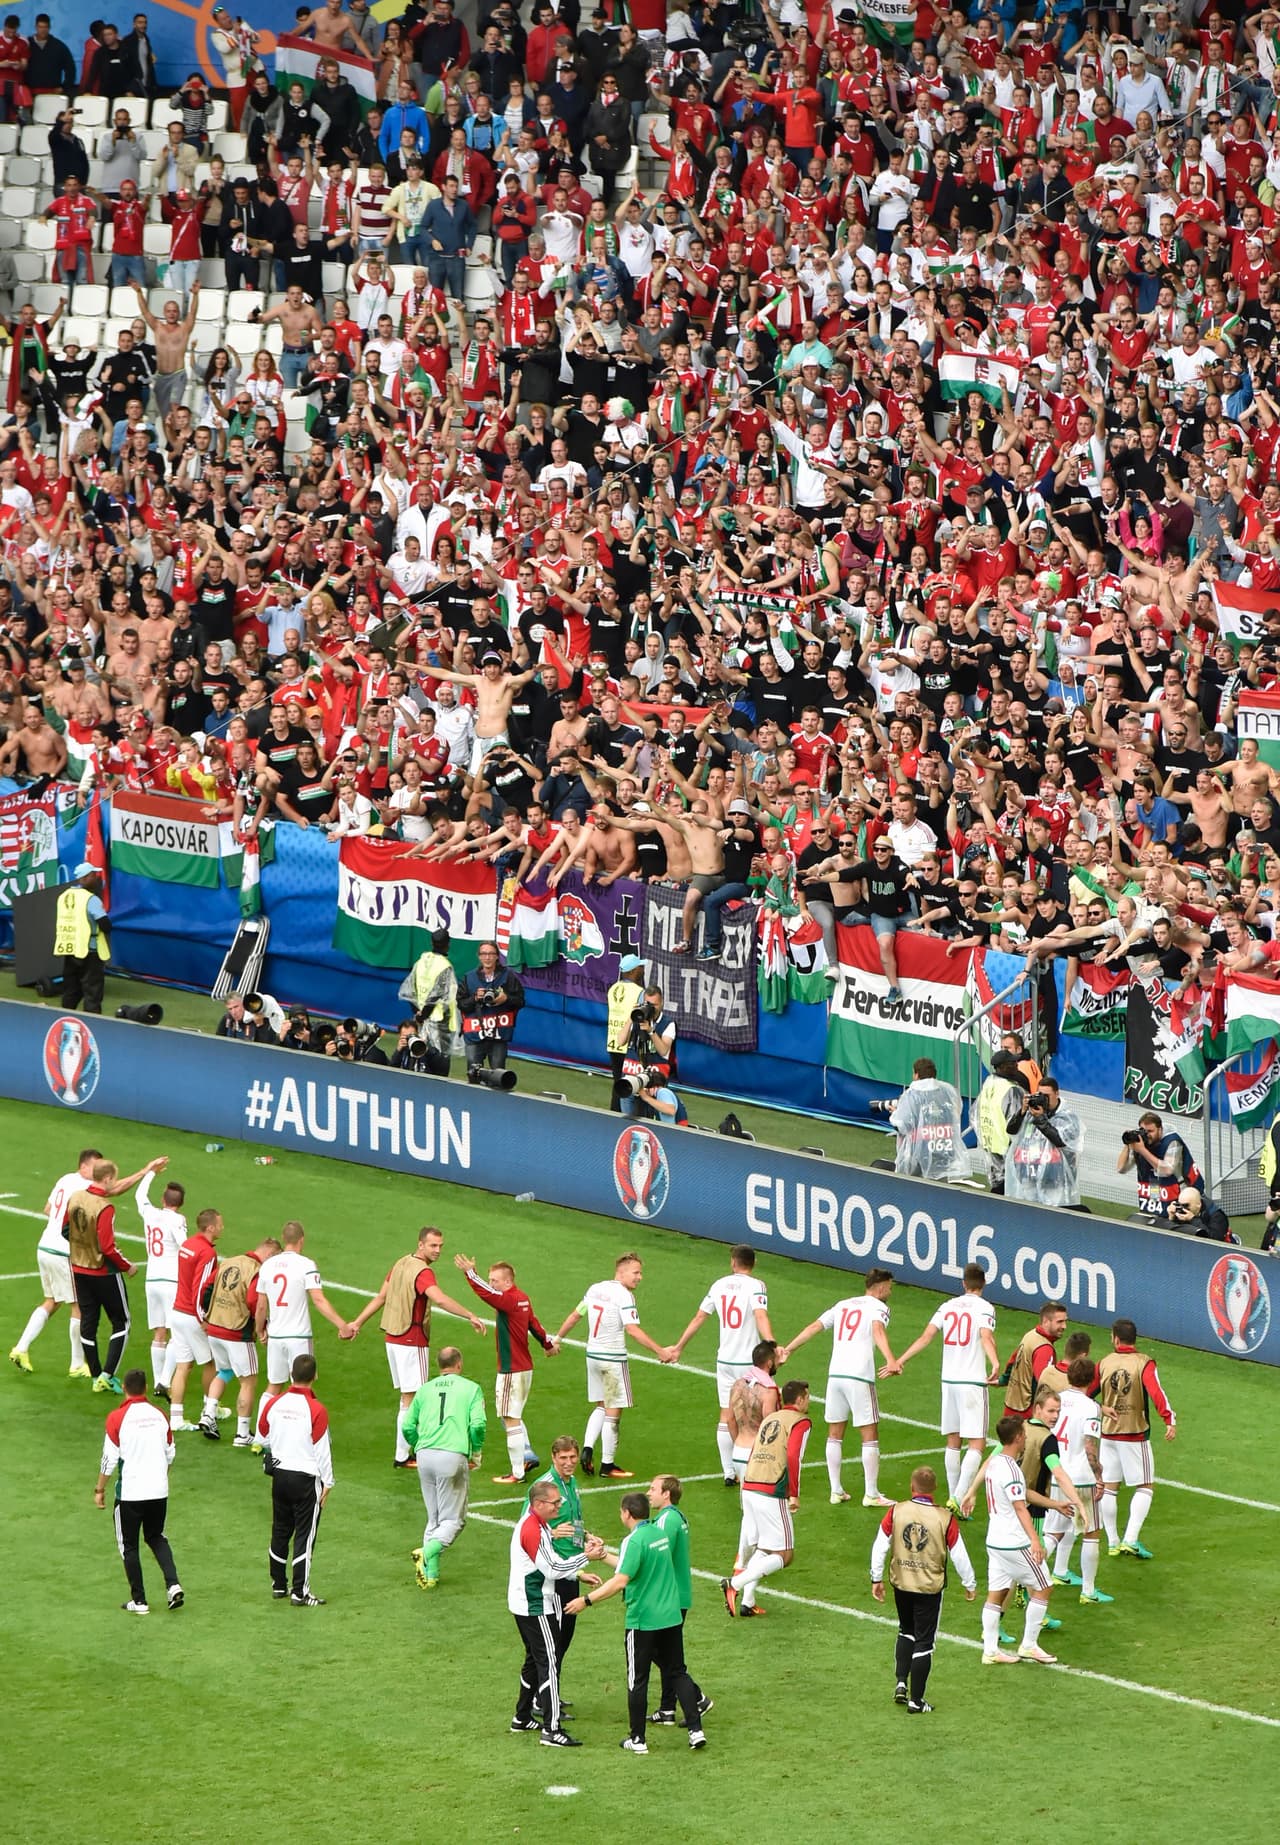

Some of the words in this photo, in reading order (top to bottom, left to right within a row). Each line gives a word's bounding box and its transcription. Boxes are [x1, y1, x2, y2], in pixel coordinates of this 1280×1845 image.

[120, 816, 209, 853] KAPOSVÁR
[57, 943, 74, 954] 68
[842, 975, 966, 1031] Ferencváros
[245, 1077, 471, 1169] #AUTHUN
[54, 1188, 65, 1220] 9
[1139, 1198, 1163, 1215] 784
[146, 1224, 164, 1257] 18
[745, 1173, 1117, 1313] EURO2016.com
[272, 1272, 289, 1307] 2
[592, 1304, 604, 1338] 7
[720, 1294, 743, 1329] 16
[837, 1307, 863, 1341] 19
[943, 1311, 972, 1347] 20
[438, 1391, 447, 1426] 1
